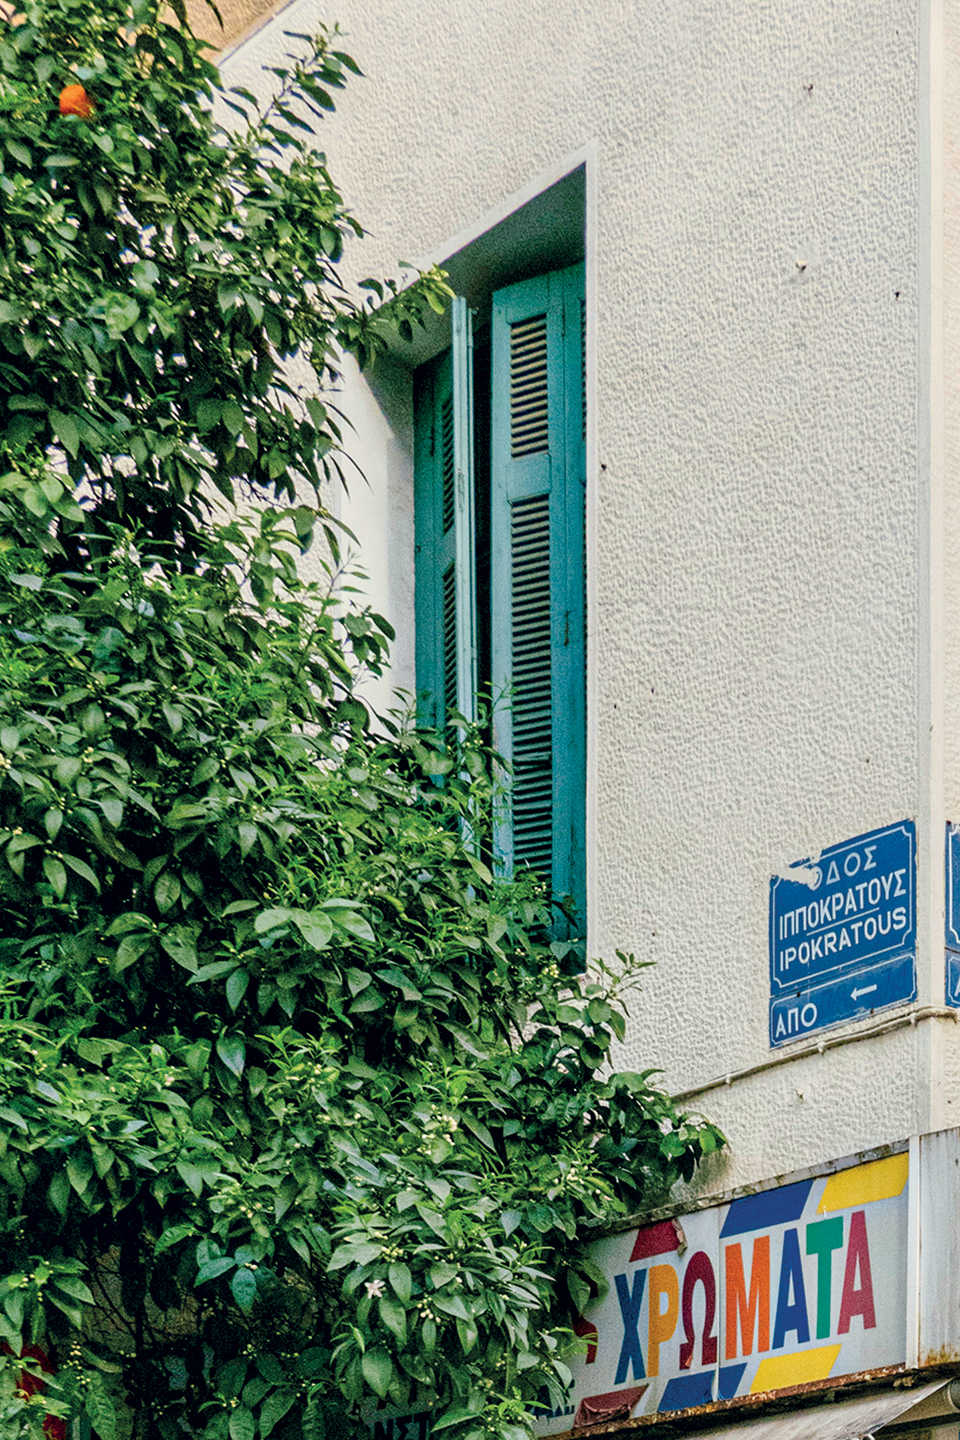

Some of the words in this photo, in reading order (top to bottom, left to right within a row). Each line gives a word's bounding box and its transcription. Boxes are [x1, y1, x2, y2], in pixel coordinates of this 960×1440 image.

[779, 868, 906, 940] ΙΠΠΟΚΡΑΤΟΥΣ
[779, 907, 907, 971] IPOKRATOUS
[775, 1002, 818, 1038] ΑΠΟ
[613, 1210, 877, 1385] ΧΡΩΜΑΤΑ
